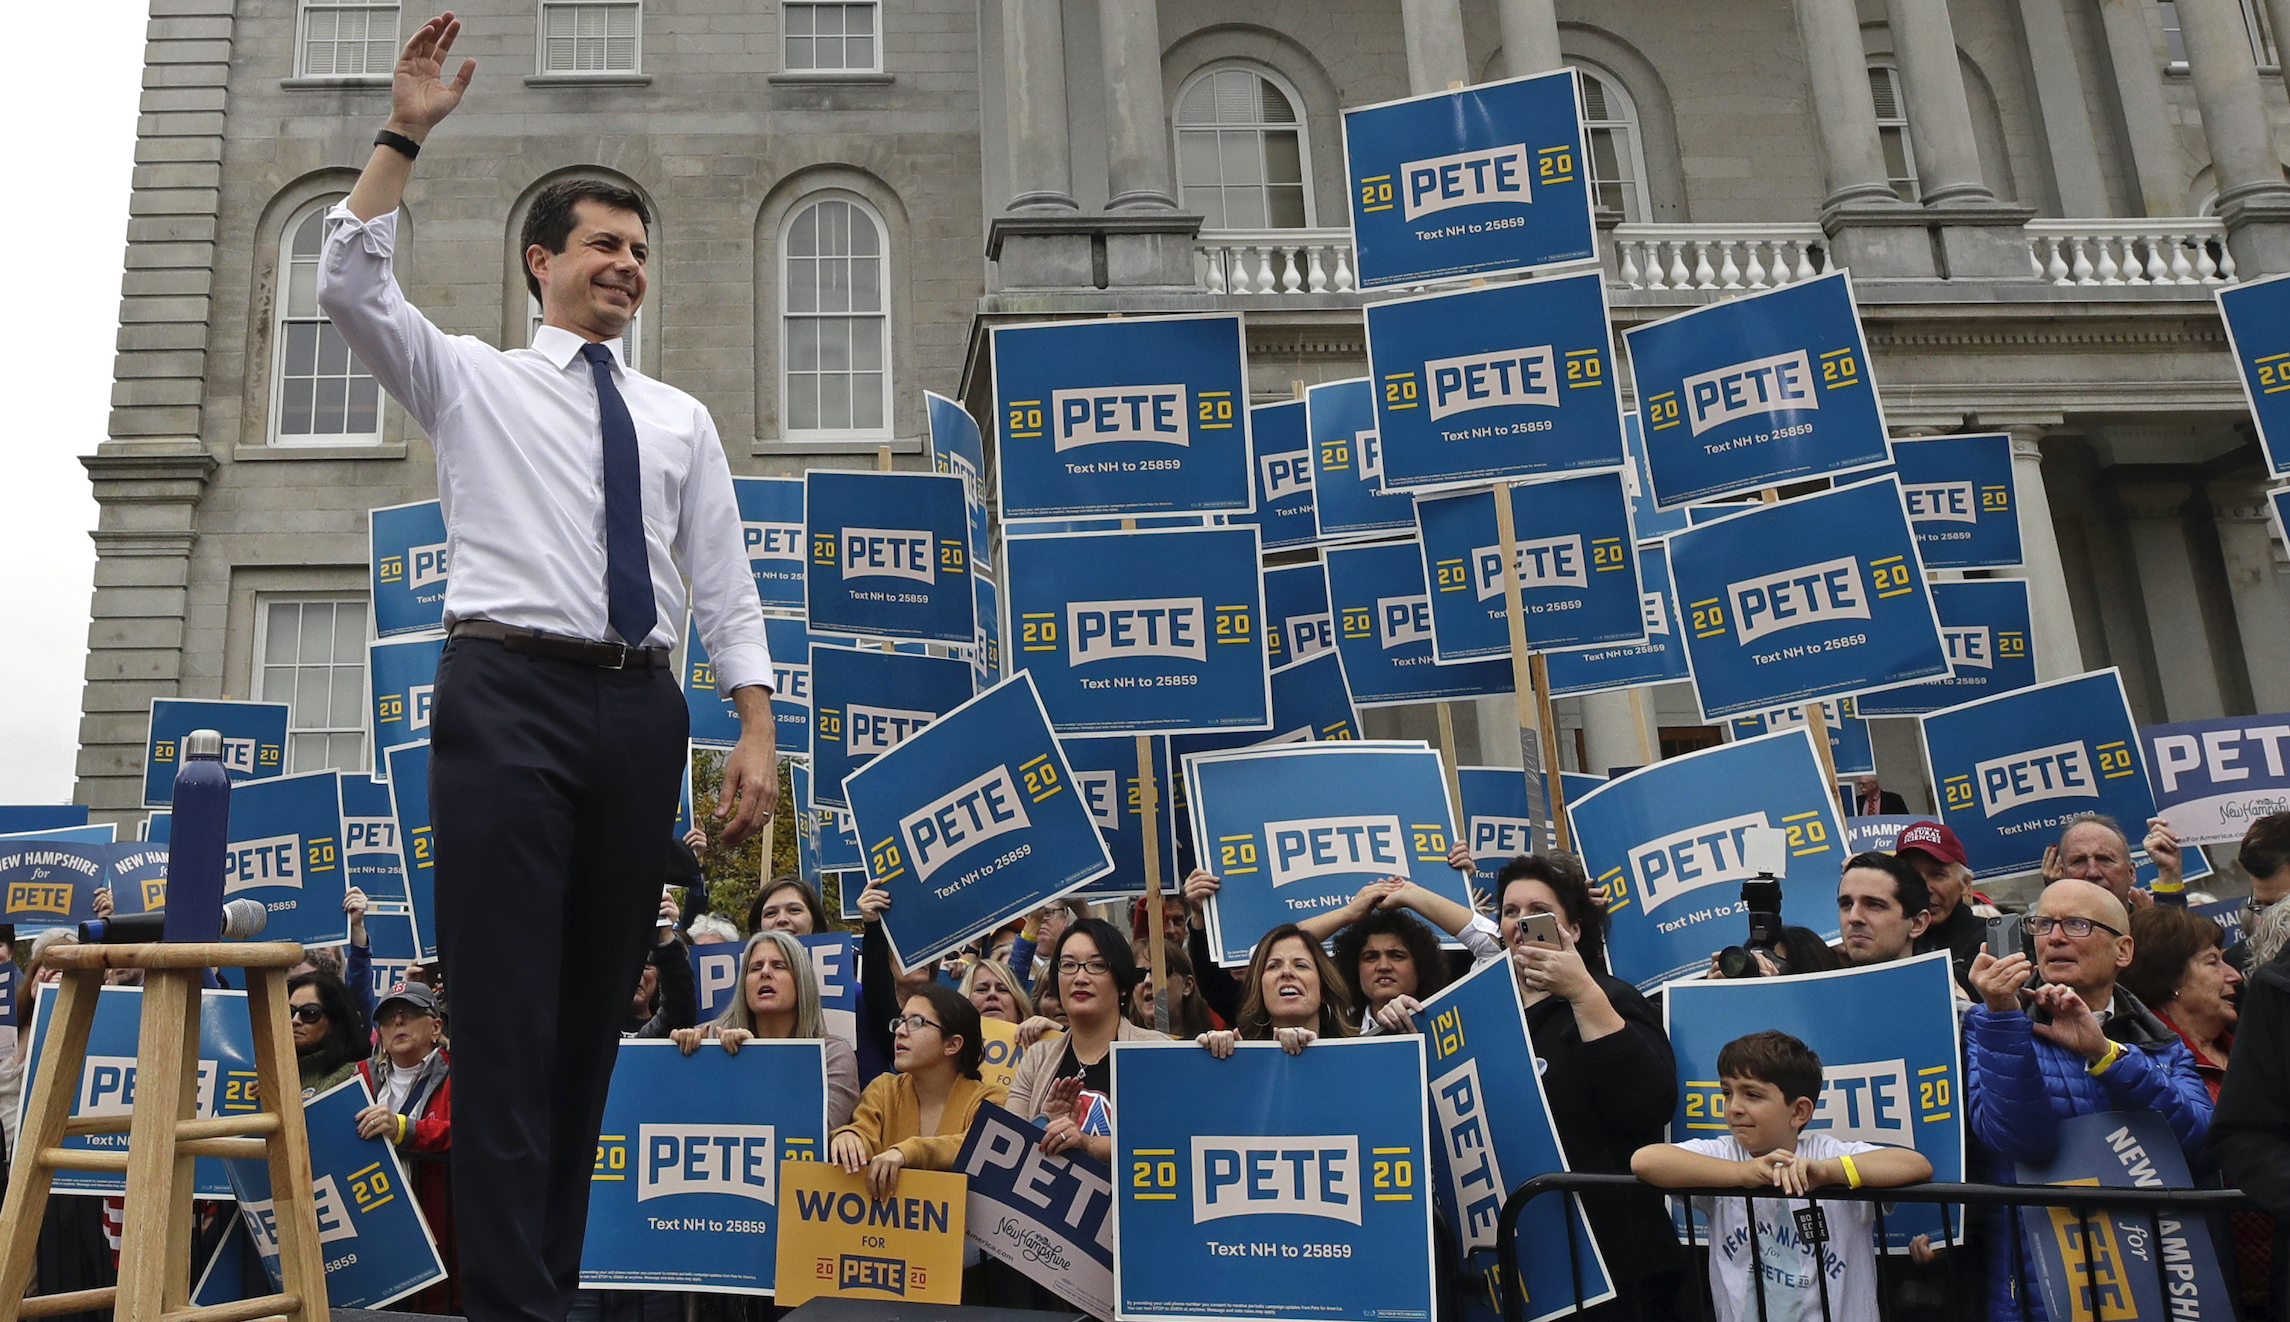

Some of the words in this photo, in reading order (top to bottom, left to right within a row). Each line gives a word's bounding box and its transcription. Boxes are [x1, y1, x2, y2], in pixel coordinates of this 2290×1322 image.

[1362, 184, 1393, 204] 20
[1410, 154, 1520, 208] PETE
[1539, 154, 1572, 176] 20
[1416, 228, 1443, 241] Text
[1446, 224, 1466, 237] NH
[1469, 223, 1482, 234] to
[1485, 217, 1525, 232] 25859
[1386, 381, 1418, 401] 20
[1435, 356, 1547, 408] PETE
[1567, 358, 1600, 380] 20
[1651, 400, 1678, 422] 20
[1692, 360, 1804, 422] PETE
[1822, 357, 1856, 381] 20
[1010, 410, 1042, 429] 20
[1062, 394, 1178, 438] PETE
[1200, 401, 1232, 420] 20
[1442, 430, 1469, 442] Text
[1472, 426, 1492, 438] NH
[1495, 425, 1508, 436] to
[1511, 420, 1552, 434] 25859
[1704, 440, 1730, 455] Text
[1734, 436, 1752, 448] NH
[1756, 432, 1768, 444] to
[1772, 423, 1813, 440] 25859
[1066, 462, 1094, 474] Text
[1098, 462, 1119, 472] NH
[1122, 462, 1136, 472] to
[1140, 460, 1180, 471] 25859
[1322, 448, 1348, 463] 20
[1268, 457, 1310, 491] PE
[1300, 505, 1314, 513] NH
[1906, 488, 1967, 515] ETE
[1983, 492, 2007, 505] 20
[744, 528, 802, 553] PET
[1929, 533, 1938, 541] to
[814, 542, 834, 558] 20
[848, 536, 928, 572] PETE
[941, 548, 963, 566] 20
[1438, 567, 1465, 584] 20
[1593, 546, 1623, 563] 20
[380, 562, 402, 576] 20
[762, 571, 777, 580] NH
[780, 572, 789, 580] to
[849, 590, 869, 600] Text
[870, 592, 884, 600] NH
[886, 592, 896, 602] to
[899, 594, 928, 604] 25859
[1532, 604, 1543, 613] to
[1547, 600, 1581, 612] 25859
[1692, 606, 1724, 631] 20
[1738, 567, 1856, 631] PETE
[1873, 565, 1910, 590] 20
[1023, 622, 1056, 642] 20
[1077, 608, 1195, 652] PETE
[1216, 614, 1250, 634] 20
[1343, 615, 1370, 631] 20
[1386, 603, 1430, 637] PE
[1583, 654, 1604, 662] Text
[1636, 644, 1665, 654] 25859
[1753, 653, 1781, 666] Text
[1784, 648, 1804, 660] NH
[1806, 644, 1821, 655] to
[1824, 634, 1866, 651] 25859
[1944, 633, 1984, 659] TE
[1999, 638, 2024, 651] 20
[1391, 658, 1416, 666] Text
[1419, 656, 1434, 664] NH
[1080, 678, 1110, 689] Text
[1114, 677, 1135, 688] NH
[1138, 677, 1152, 687] to
[1156, 675, 1198, 687] 25859
[1957, 677, 1987, 685] 25859
[380, 701, 402, 716] 20
[778, 715, 806, 724] 25859
[820, 718, 840, 732] 20
[156, 746, 174, 757] 20
[260, 750, 279, 760] 20
[2153, 725, 2290, 793] PET
[1946, 783, 1972, 802] 20
[1984, 751, 2085, 804] PETE
[2100, 750, 2131, 771] 20
[873, 846, 901, 874] 20
[910, 778, 1015, 864] PETE
[1024, 763, 1058, 794] 20
[1997, 826, 2022, 836] Text
[2024, 821, 2042, 831] NH
[2044, 818, 2056, 827] to
[1786, 820, 1826, 846] 20
[1873, 838, 1892, 849] for
[309, 846, 335, 863] 20
[1221, 844, 1256, 865] 20
[1275, 826, 1397, 872] PETE
[1413, 834, 1446, 852] 20
[25, 852, 99, 877] HAMPSHIRE
[31, 868, 50, 880] for
[115, 853, 143, 874] NEW
[934, 882, 961, 900] Text
[960, 870, 980, 887] NH
[980, 864, 994, 877] to
[994, 844, 1032, 870] 25859
[1475, 870, 1494, 878] Text
[11, 888, 68, 908] PETE
[267, 901, 297, 911] 25859
[1285, 898, 1317, 910] Text
[1320, 896, 1342, 907] NH
[1657, 916, 1686, 934] Text
[1690, 910, 1712, 923] NH
[1714, 906, 1730, 917] to
[996, 1075, 1011, 1085] FO
[1920, 1079, 1950, 1109] 20
[85, 1135, 112, 1146] Text
[649, 1136, 766, 1187] PETE
[1441, 1074, 1499, 1238] PETE
[2105, 1126, 2163, 1187] NEW
[352, 1172, 389, 1204] 20
[1133, 1162, 1176, 1187] 20
[1204, 1149, 1349, 1205] PETE
[1373, 1161, 1412, 1187] 20
[796, 1190, 948, 1233] WOMEN
[648, 1218, 680, 1230] Text
[684, 1219, 705, 1230] NH
[708, 1220, 723, 1231] to
[727, 1220, 766, 1233] 25859
[862, 1236, 885, 1248] FOR
[966, 1230, 1014, 1262] America.com
[1207, 1242, 1246, 1256] Text
[1251, 1243, 1277, 1257] NH
[1282, 1244, 1298, 1258] to
[1303, 1244, 1352, 1258] 25859
[1765, 1247, 1780, 1258] for
[2119, 1222, 2148, 1261] for
[817, 1264, 833, 1274] 20
[843, 1260, 902, 1288] PETE
[911, 1273, 926, 1284] 20
